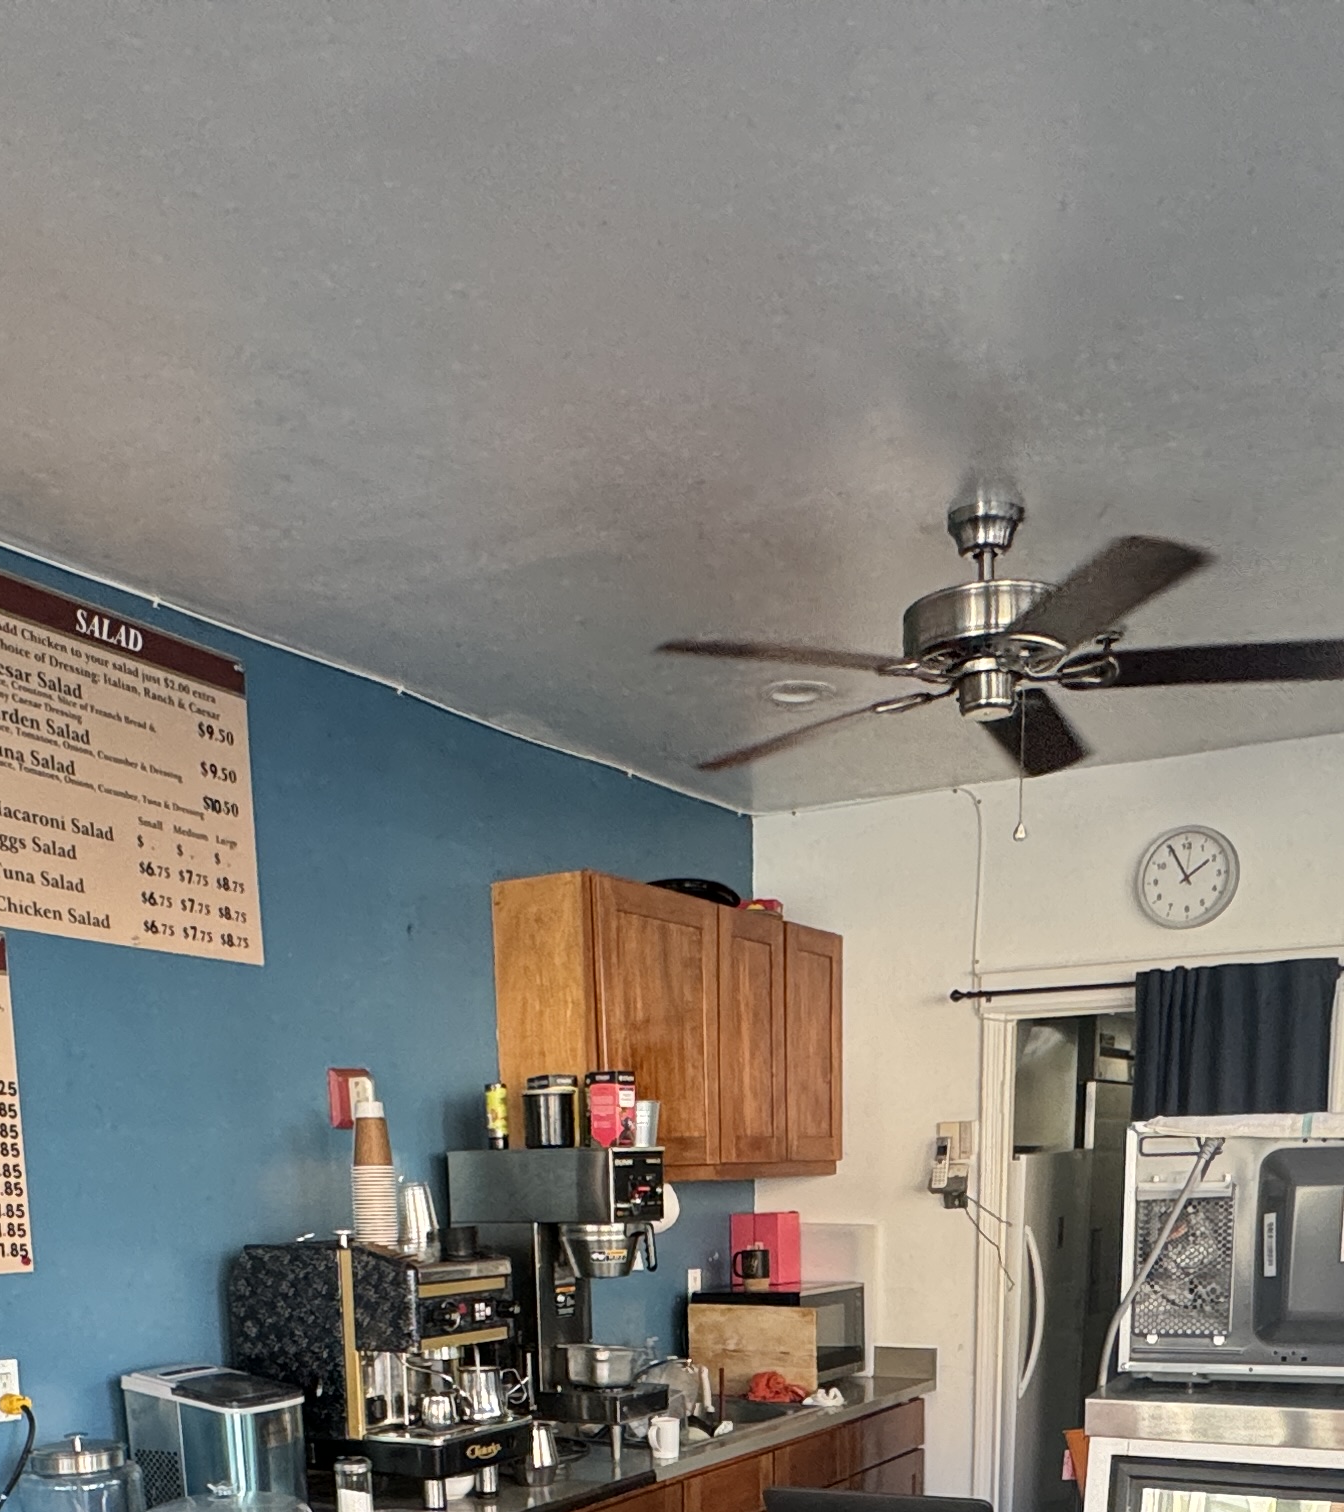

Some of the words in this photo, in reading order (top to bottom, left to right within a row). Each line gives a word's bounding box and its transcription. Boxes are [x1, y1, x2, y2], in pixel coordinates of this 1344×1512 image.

[75, 608, 143, 652] SALAD
[37, 671, 83, 700] Salad
[197, 721, 235, 746] $9.50
[30, 749, 76, 777] Salad
[202, 795, 239, 818] $10.50
[31, 836, 78, 860] Salad
[139, 861, 171, 879] $6.75
[178, 869, 209, 887] $7.75
[216, 876, 245, 894] $8.75
